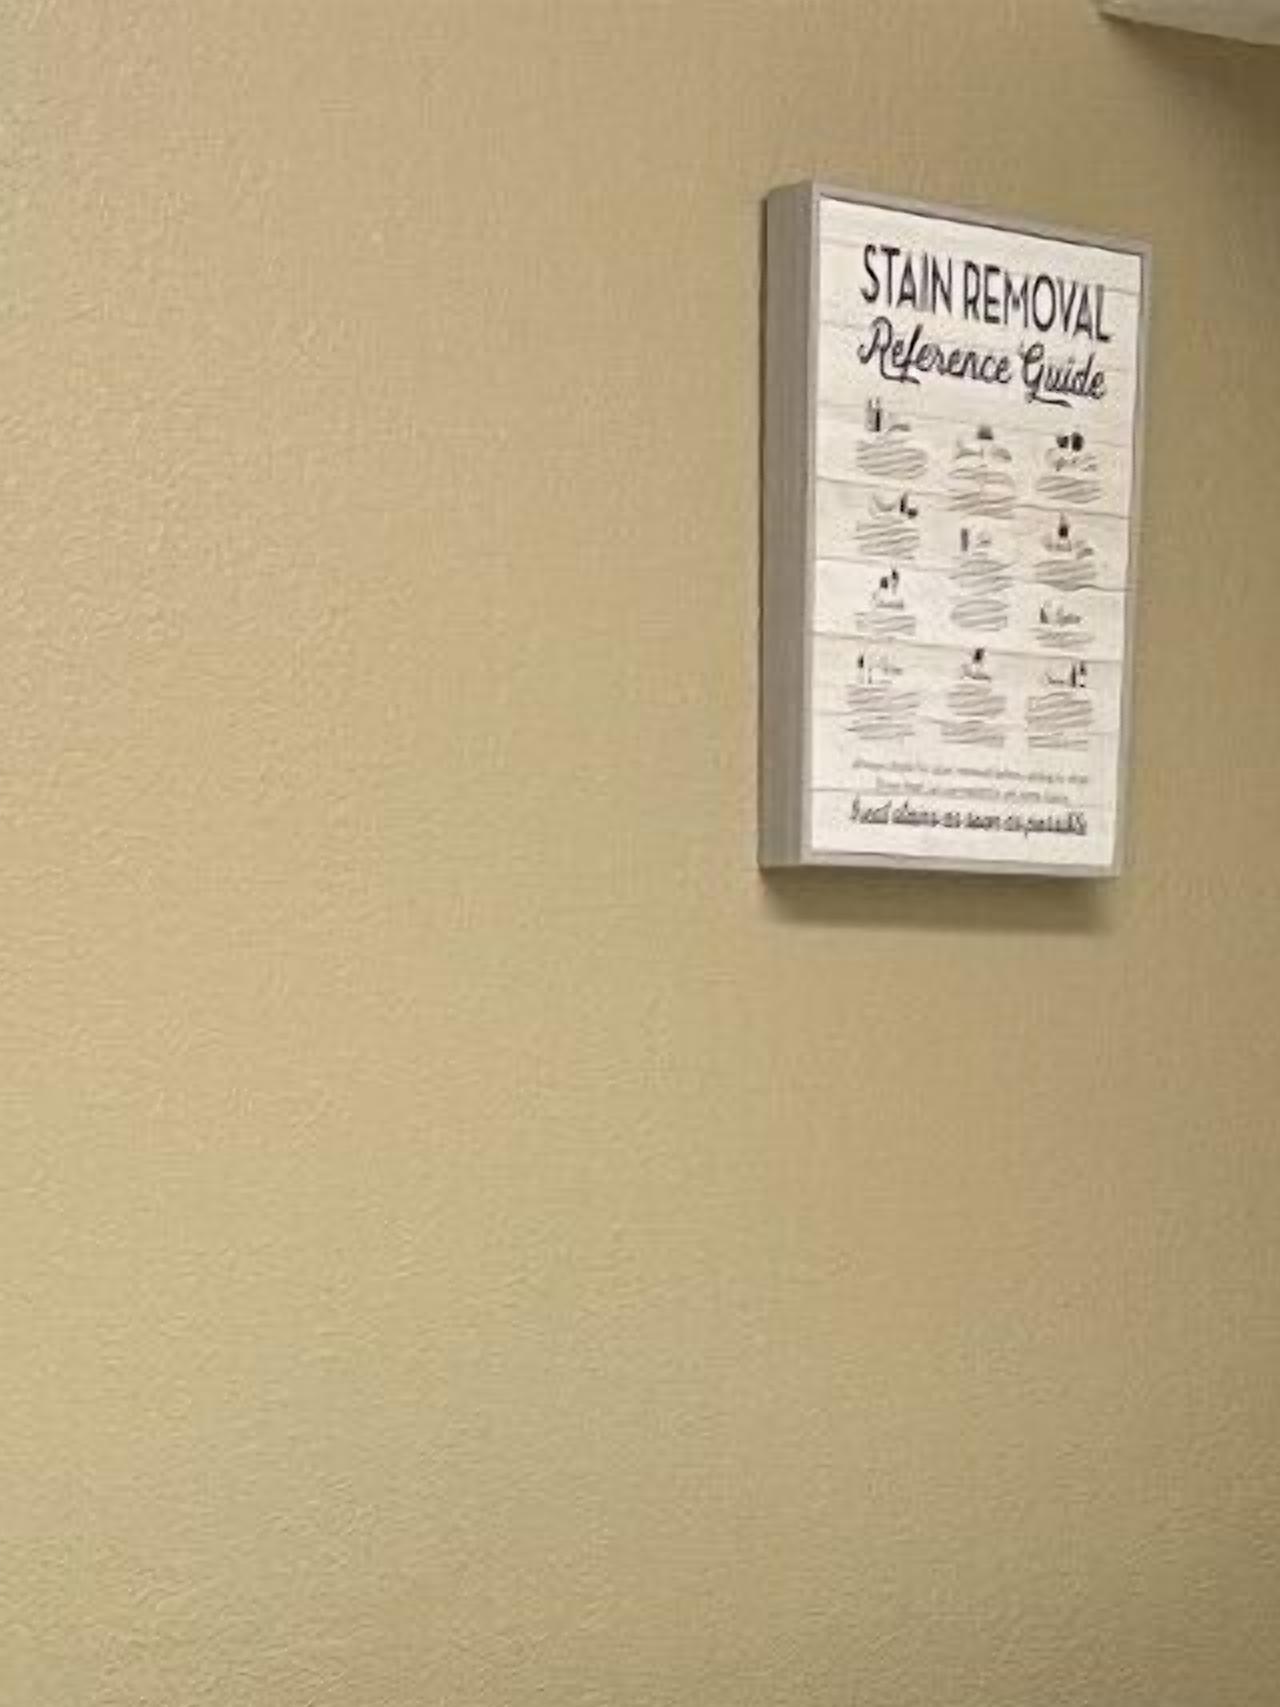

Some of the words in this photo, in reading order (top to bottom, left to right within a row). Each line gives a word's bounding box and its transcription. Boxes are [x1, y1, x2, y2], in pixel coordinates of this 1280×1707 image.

[859, 244, 953, 315] STAIN
[963, 259, 1110, 343] REMOVAL
[856, 315, 1013, 385] Reference
[1018, 341, 1108, 408] Guide
